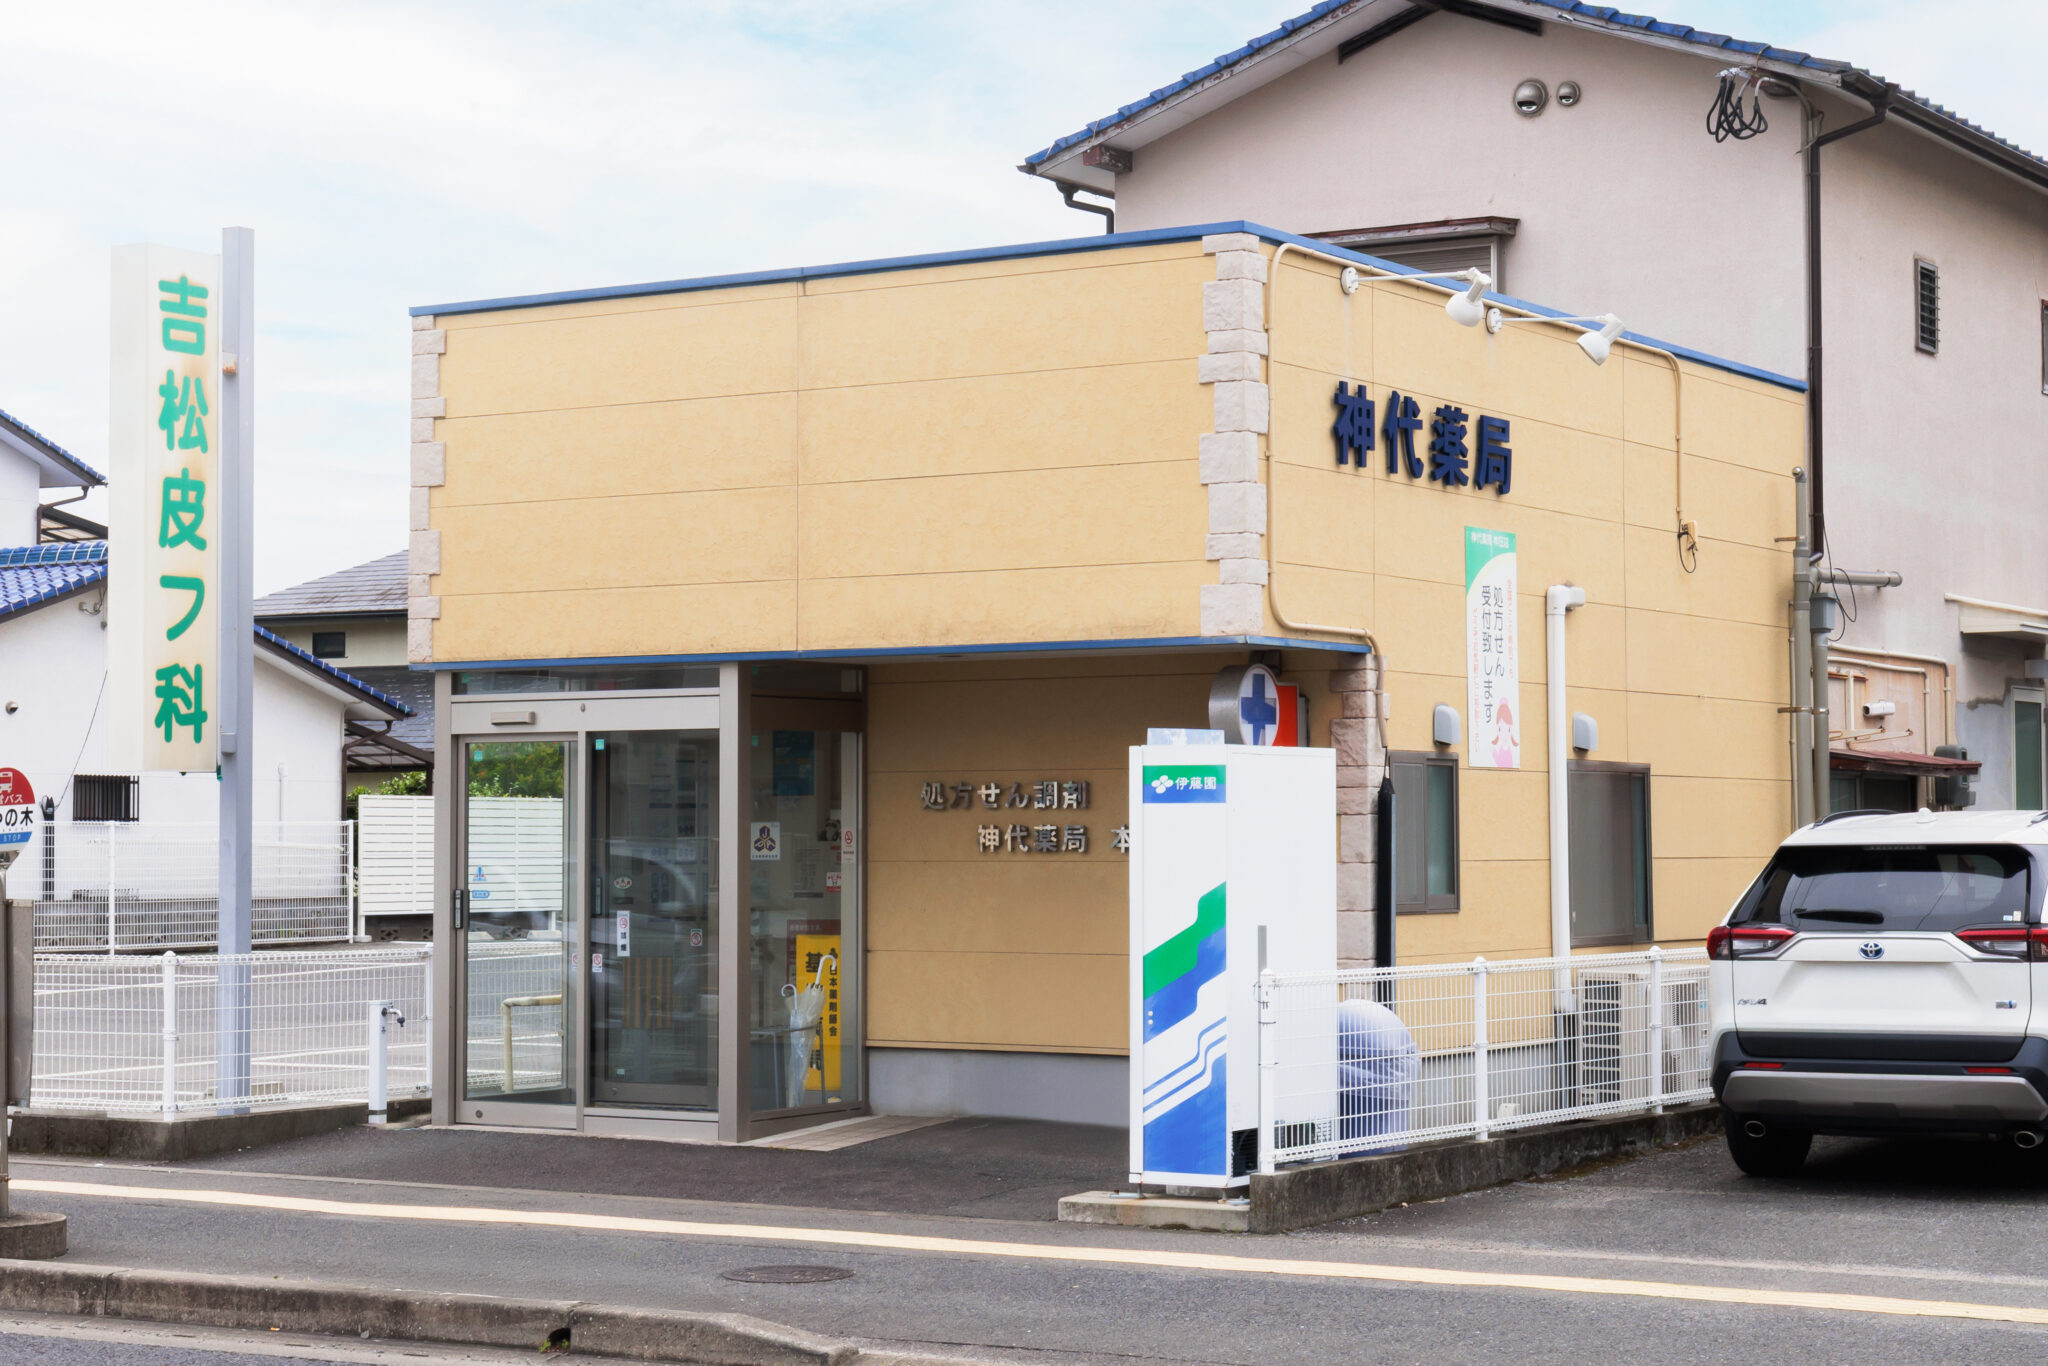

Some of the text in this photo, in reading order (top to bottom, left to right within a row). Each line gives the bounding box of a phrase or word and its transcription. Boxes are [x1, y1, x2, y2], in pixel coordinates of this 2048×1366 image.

[1333, 380, 1513, 495] 神代薬局
[154, 273, 209, 744] 吉松皮フ科
[1481, 585, 1493, 723] 受付致します
[1493, 586, 1505, 677] 処方せん
[920, 780, 1090, 810] 処方せん調剤
[1175, 776, 1217, 790] 伊藤園
[976, 824, 1089, 853] 神代薬局
